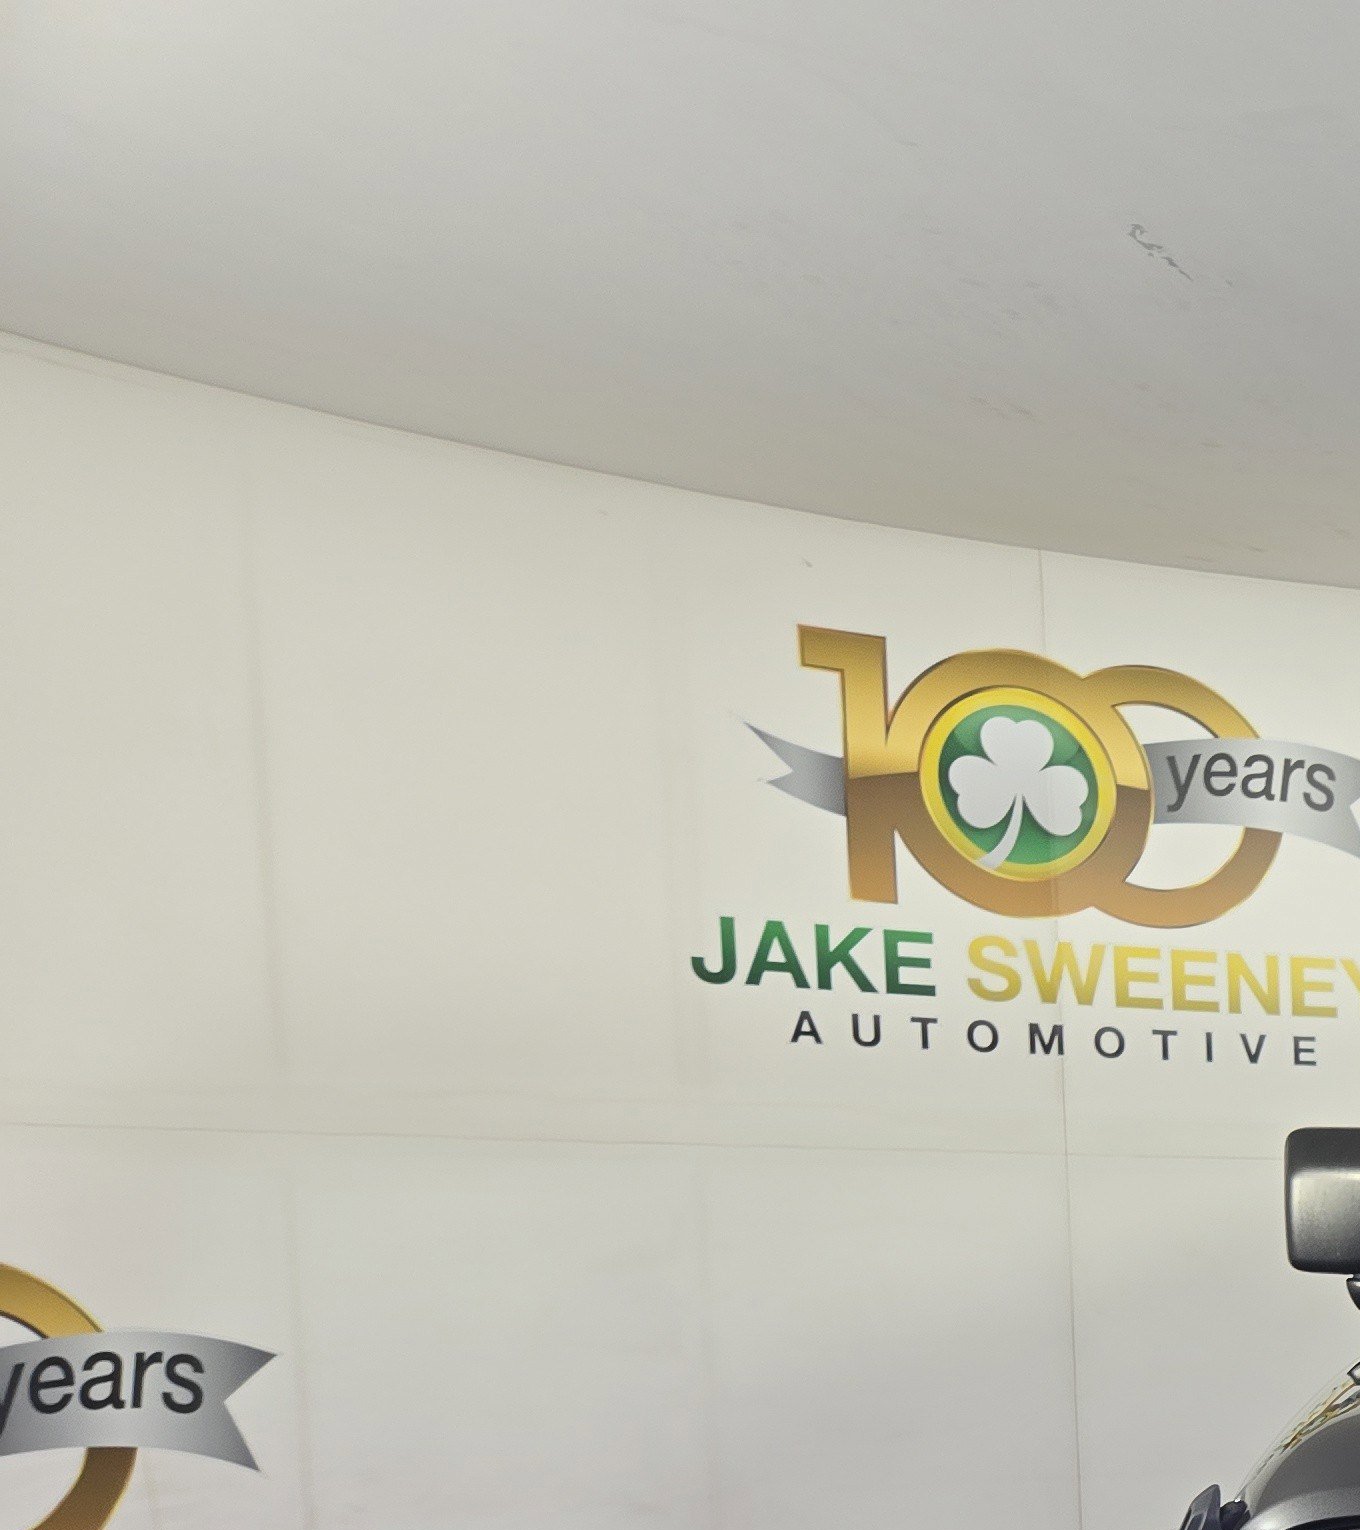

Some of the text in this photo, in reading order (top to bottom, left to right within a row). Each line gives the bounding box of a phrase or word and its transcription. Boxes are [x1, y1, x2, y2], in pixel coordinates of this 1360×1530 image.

[1166, 750, 1337, 812] years
[690, 915, 937, 997] JAKE
[790, 1010, 1317, 1067] AUTOMOTIVE
